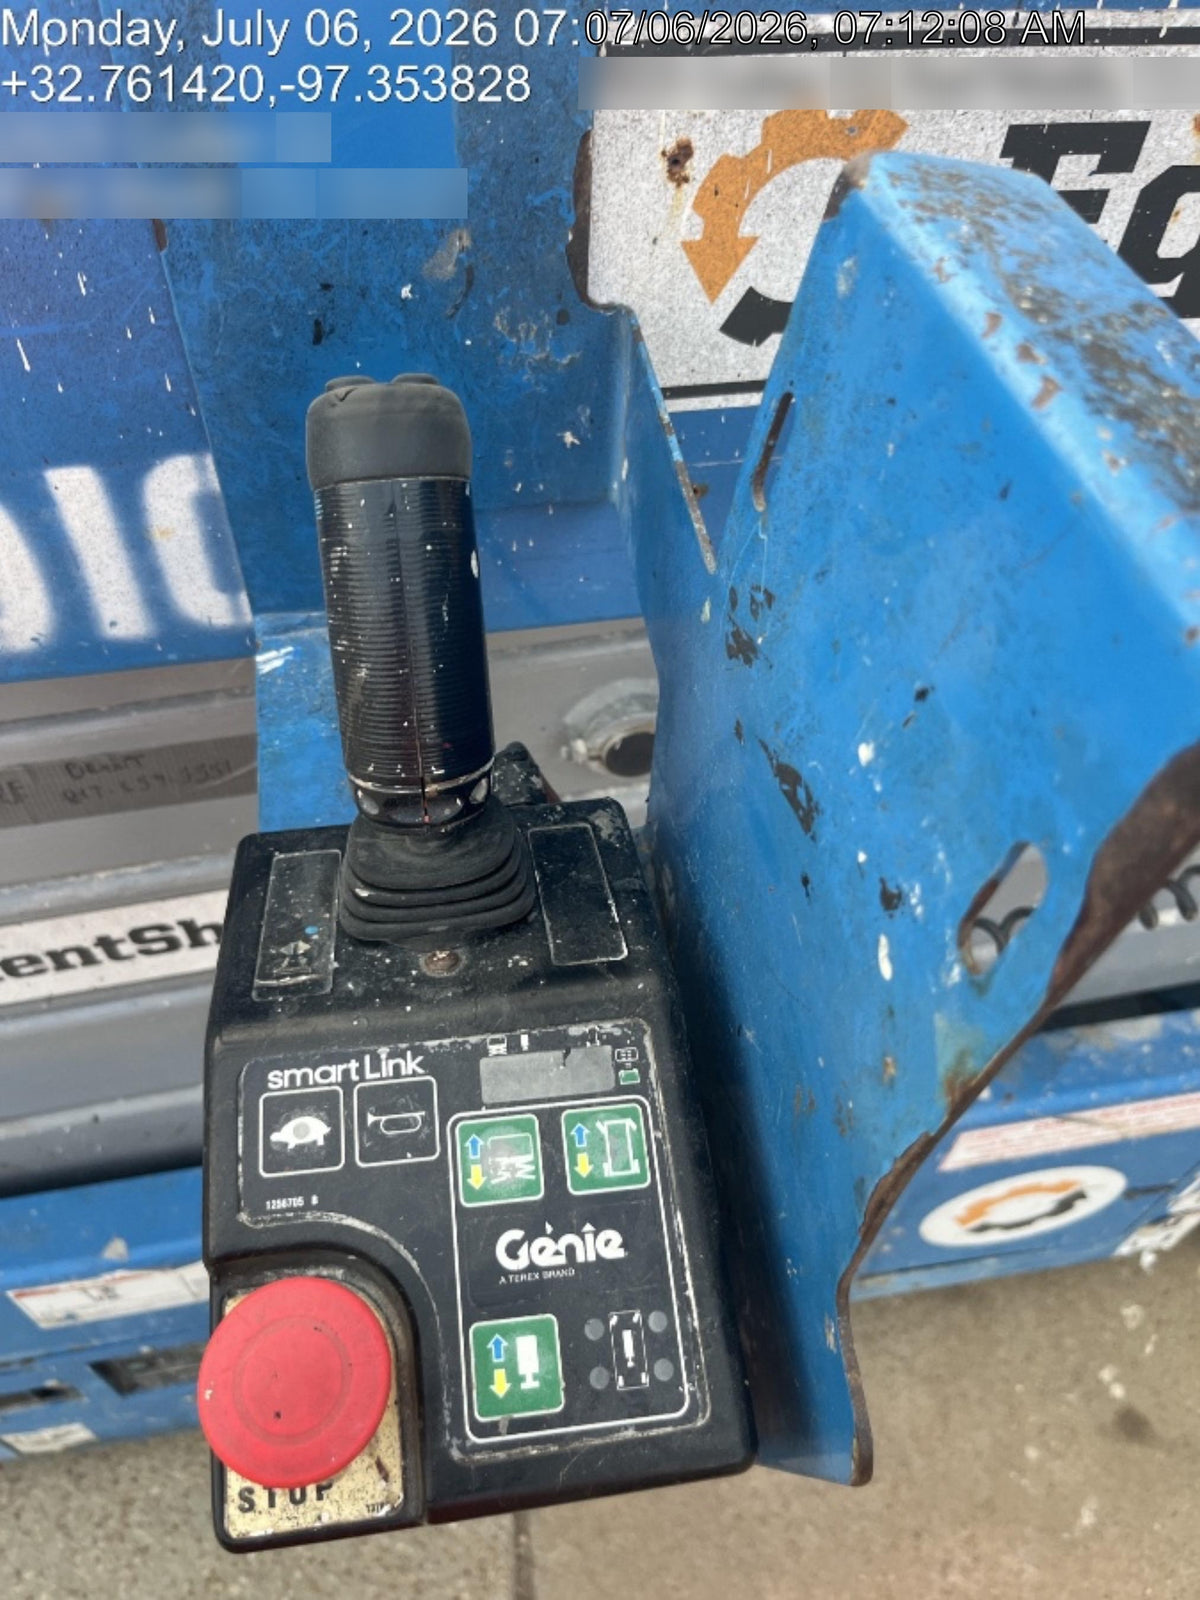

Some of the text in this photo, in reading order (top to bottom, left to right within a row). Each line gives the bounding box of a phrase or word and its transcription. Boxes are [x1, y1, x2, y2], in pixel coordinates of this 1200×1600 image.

[0, 917, 223, 982] entSh
[495, 1221, 626, 1271] Genie
[508, 1271, 540, 1283] TEREX
[541, 1267, 576, 1279] BRAND
